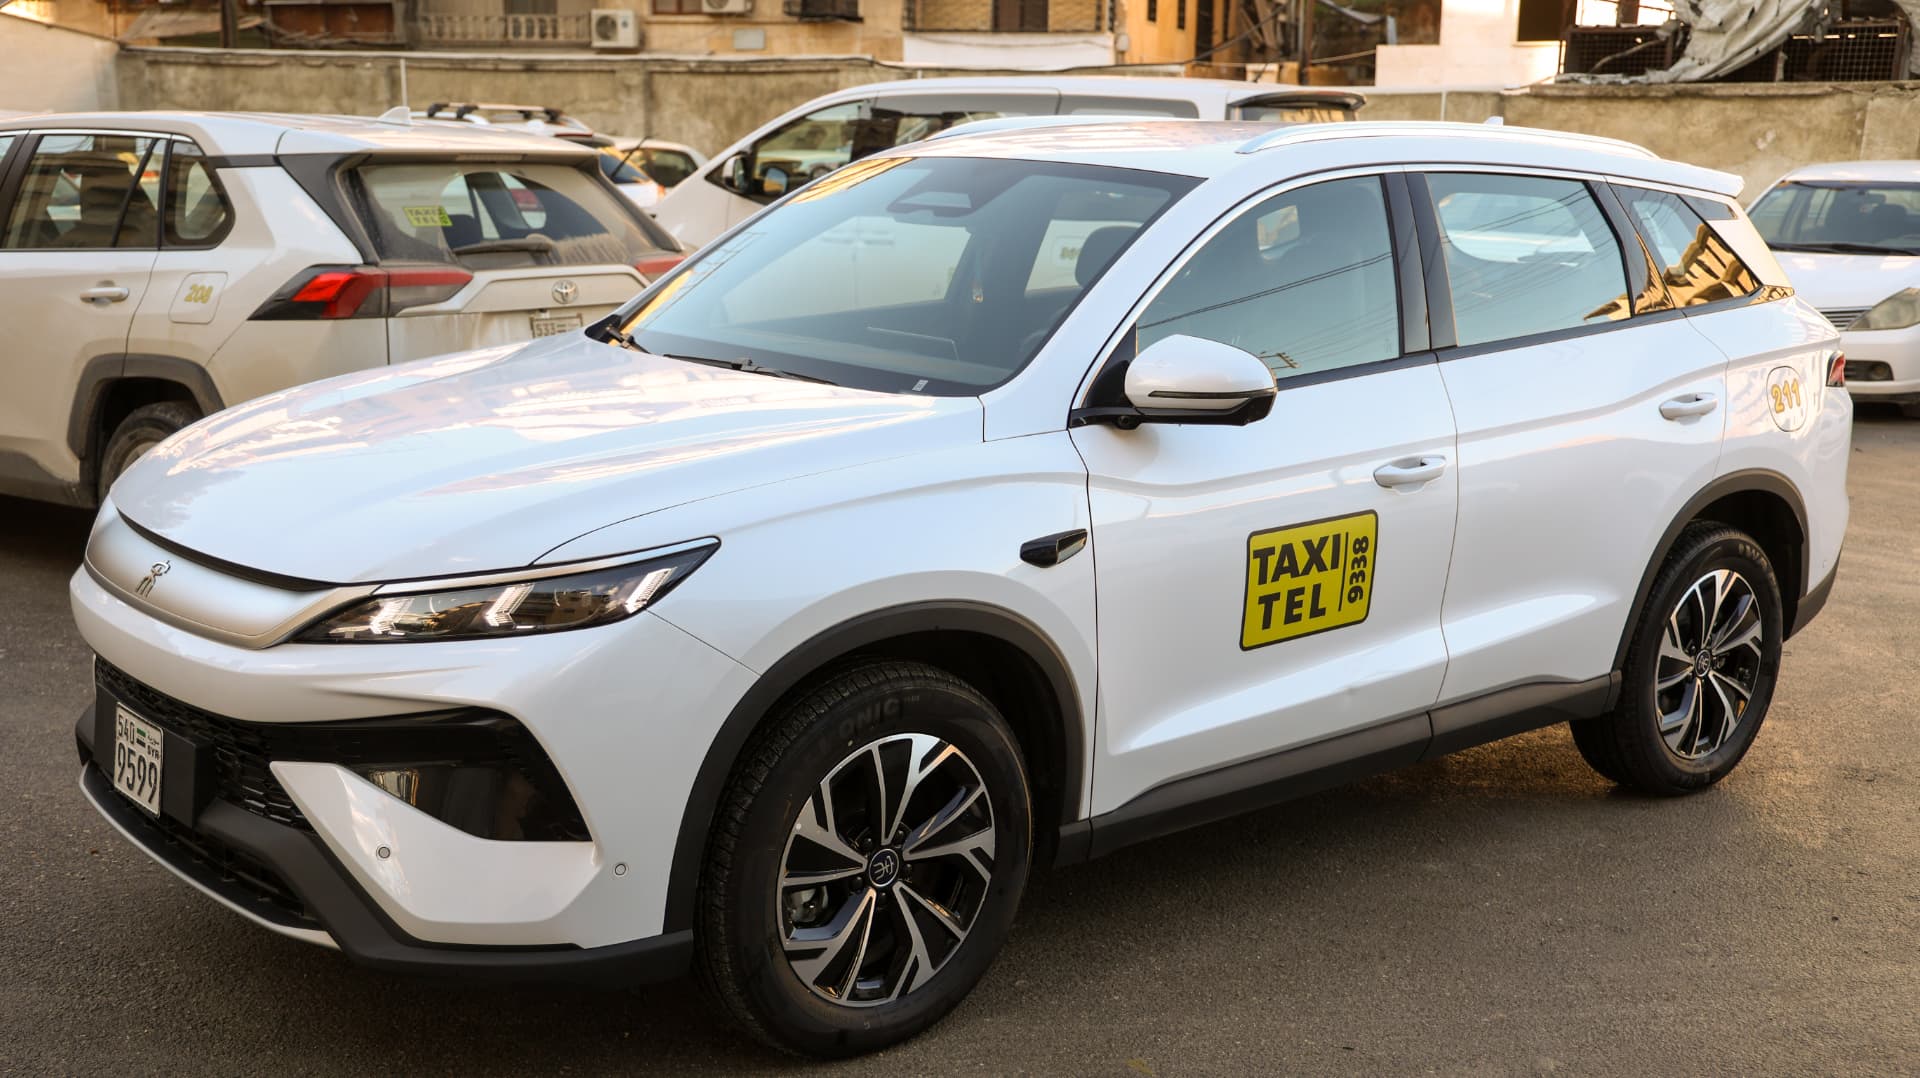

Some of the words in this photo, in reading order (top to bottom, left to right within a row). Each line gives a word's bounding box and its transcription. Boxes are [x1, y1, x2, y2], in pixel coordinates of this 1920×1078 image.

[1771, 378, 1801, 414] 211
[1253, 533, 1341, 585] TAXI
[1347, 535, 1369, 604] 9338
[1258, 583, 1326, 631] TEL
[118, 714, 135, 745] 540
[117, 742, 158, 804] 9599
